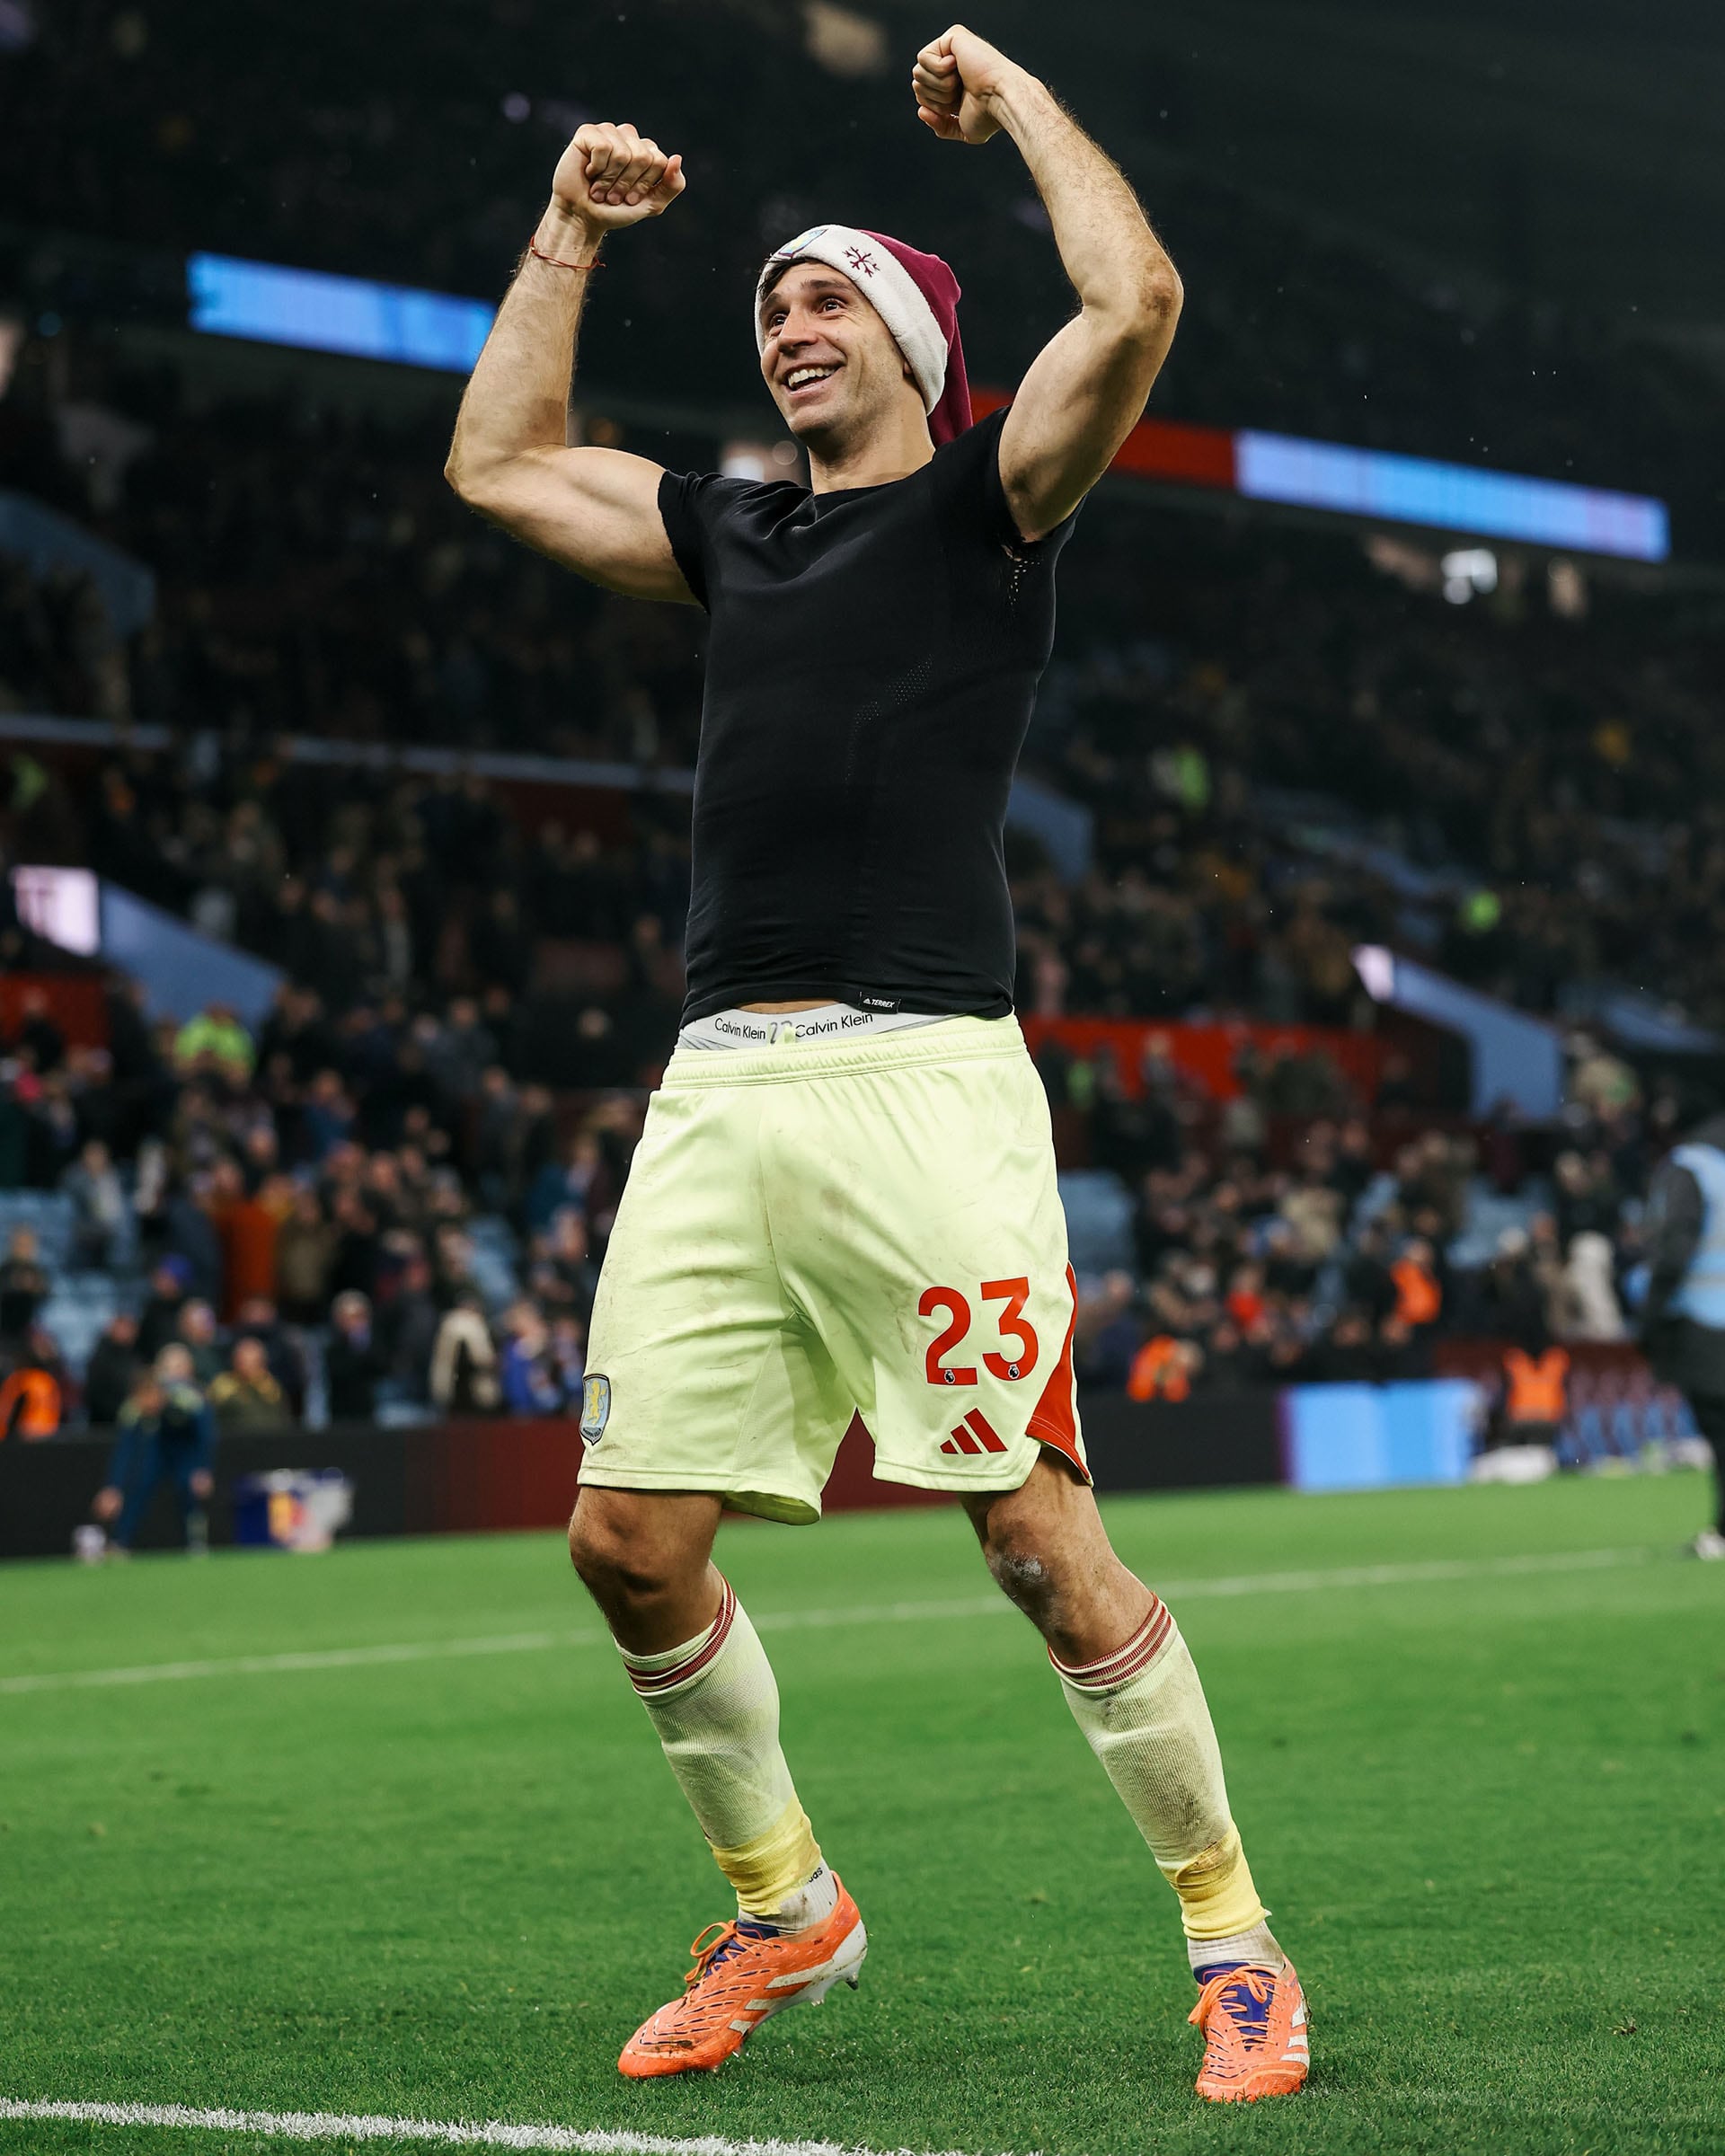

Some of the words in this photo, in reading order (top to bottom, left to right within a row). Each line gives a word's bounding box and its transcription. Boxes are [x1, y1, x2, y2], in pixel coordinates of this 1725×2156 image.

[871, 998, 895, 1008] TERREX
[714, 1017, 741, 1037] Calvin
[742, 1025, 766, 1039] Klein
[795, 1019, 837, 1038] Calvin
[842, 1012, 873, 1029] Klein
[918, 1277, 1039, 1385] 23
